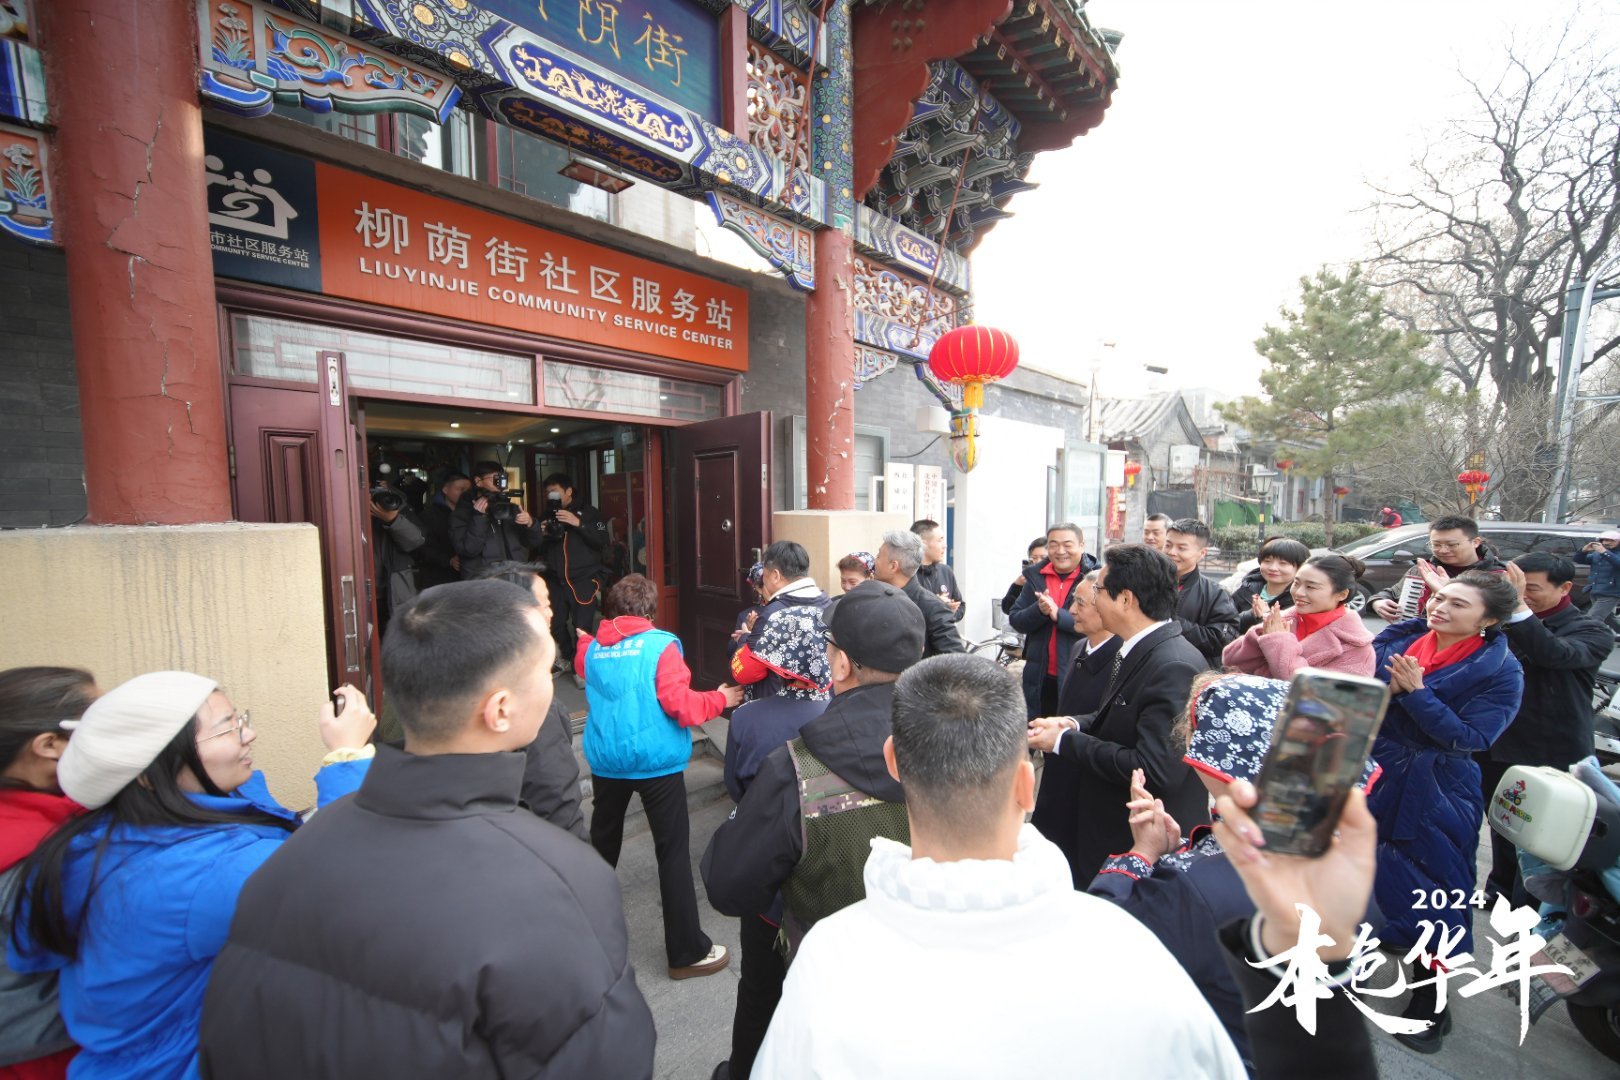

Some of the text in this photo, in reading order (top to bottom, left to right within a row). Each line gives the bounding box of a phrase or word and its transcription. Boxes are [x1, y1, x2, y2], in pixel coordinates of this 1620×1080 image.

[210, 230, 310, 262] 市社区服务站
[211, 245, 310, 268] OMMUNITY SERVICE CENTER
[354, 201, 733, 332] 柳荫街社区服务站
[359, 257, 733, 350] LIUYINJIE COMMUNITY SERVICE CENTER
